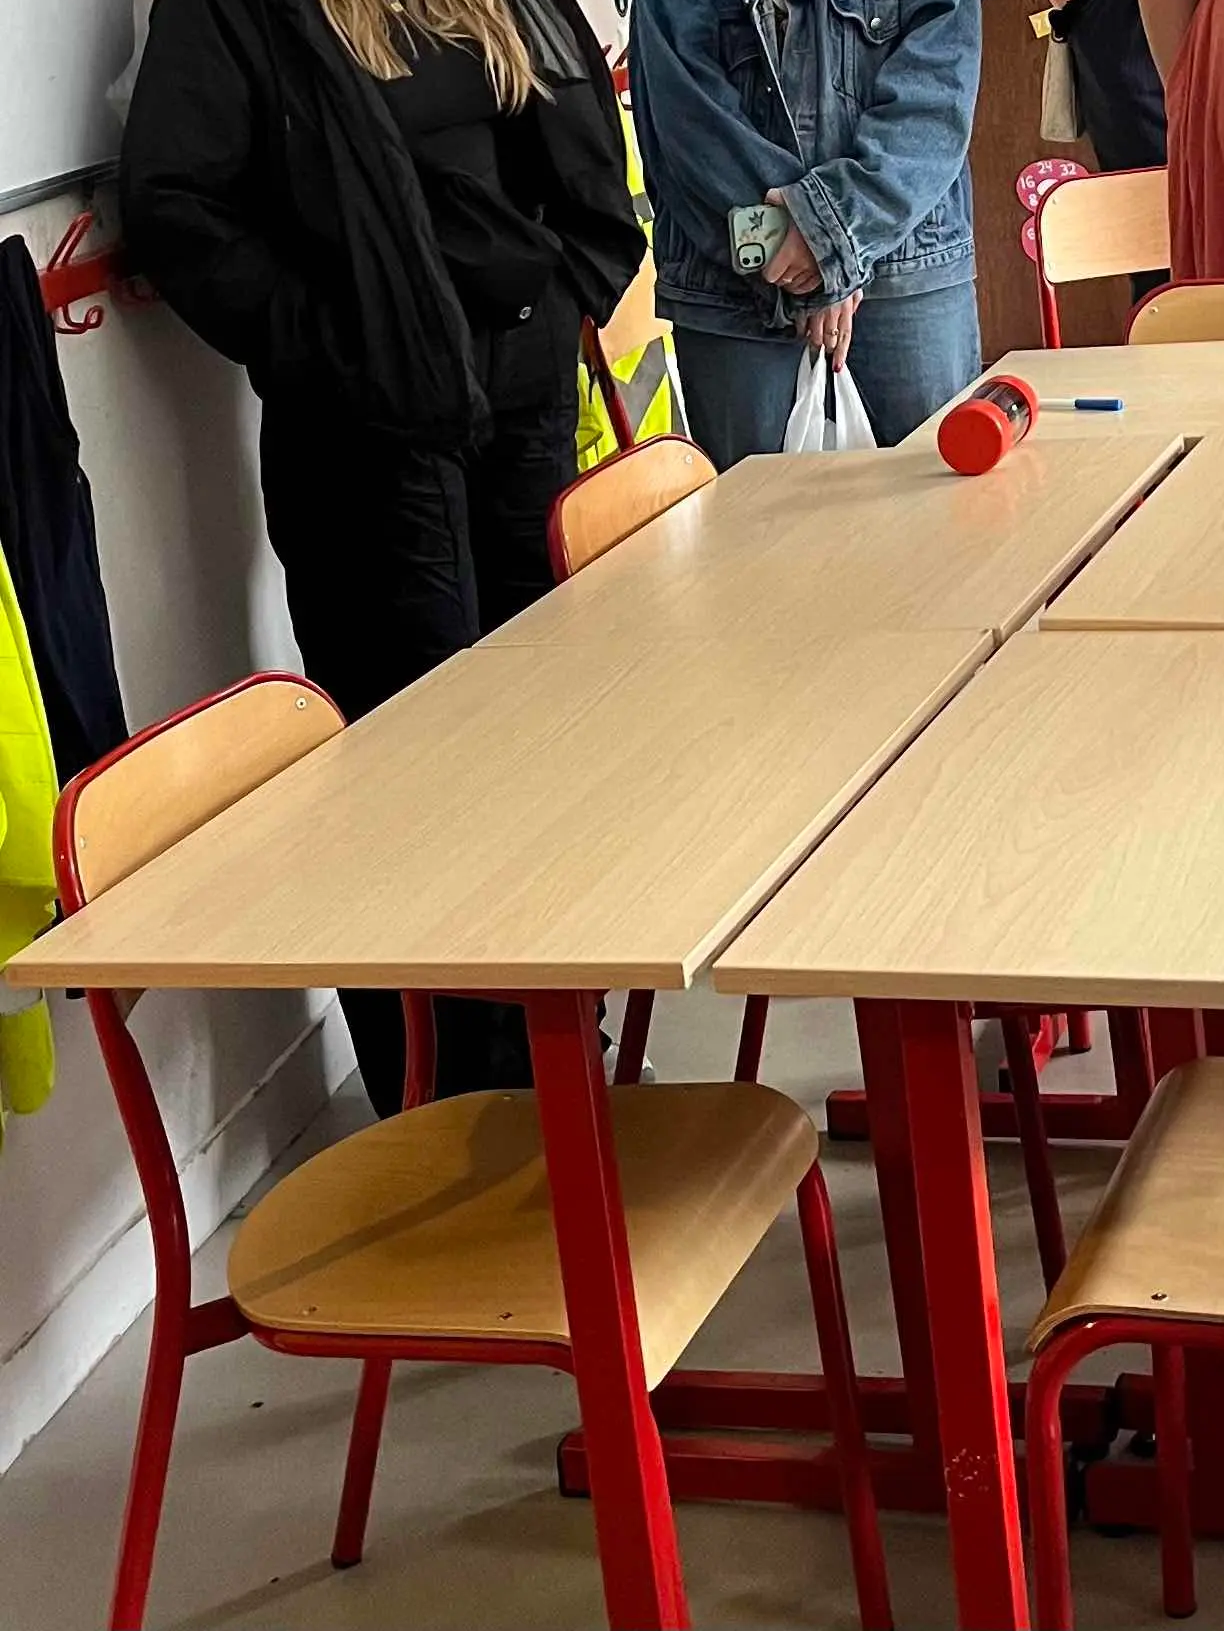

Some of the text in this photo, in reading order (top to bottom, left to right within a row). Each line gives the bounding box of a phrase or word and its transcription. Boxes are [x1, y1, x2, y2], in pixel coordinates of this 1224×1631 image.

[1038, 161, 1077, 176] 24 32
[1020, 175, 1036, 190] 16
[1028, 193, 1039, 207] 8
